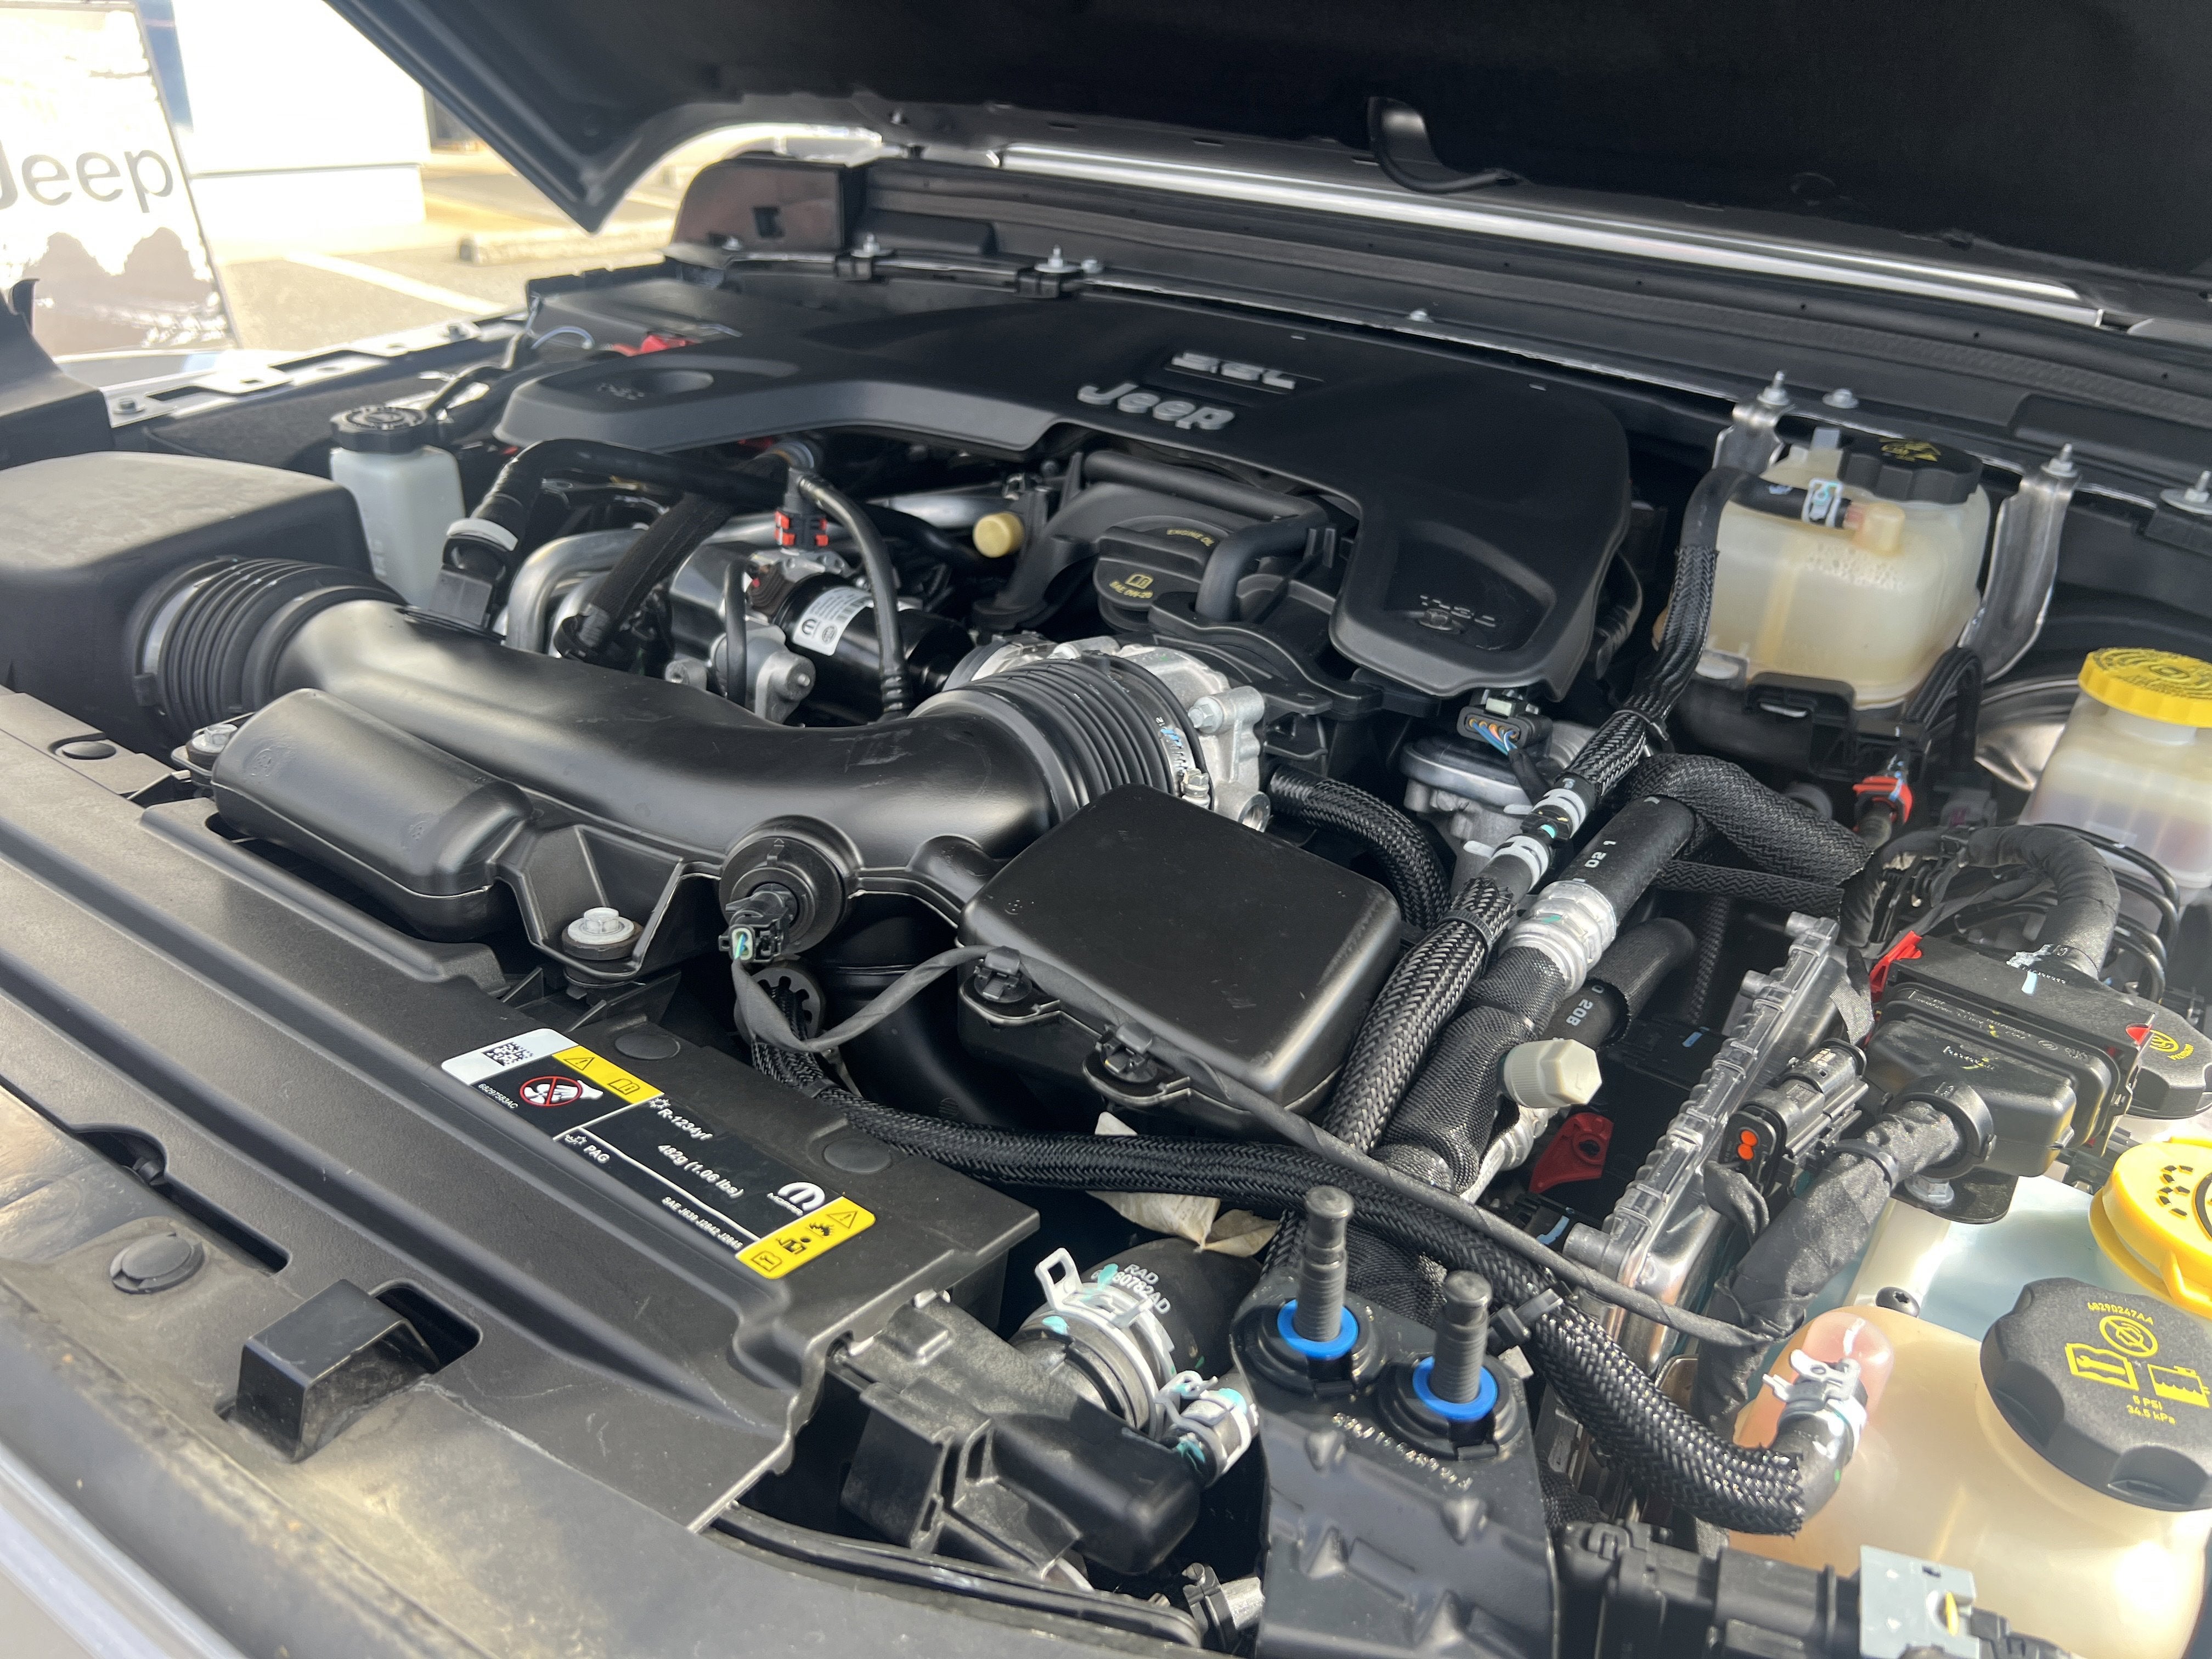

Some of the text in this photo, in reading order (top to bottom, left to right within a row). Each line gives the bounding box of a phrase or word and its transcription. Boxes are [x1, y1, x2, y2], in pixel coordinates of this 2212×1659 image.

[1076, 382, 1235, 431] Jeep
[1166, 529, 1215, 546] ENGINE OIL
[1109, 580, 1126, 594] SAE
[478, 1082, 519, 1110] 68297583AC
[657, 1108, 714, 1141] R-1234yf
[583, 1144, 611, 1164] PAG
[657, 1144, 744, 1199] 482g (1.06 lbs)
[766, 1192, 804, 1217] MOPAR
[661, 1197, 743, 1251] SAE J639 J2842 J2845
[1124, 1263, 1159, 1285] RAD
[2087, 1301, 2154, 1326] 68290247AA
[2126, 1404, 2177, 1426] 34.5 kPa
[2132, 1395, 2163, 1411] 5 PSI
